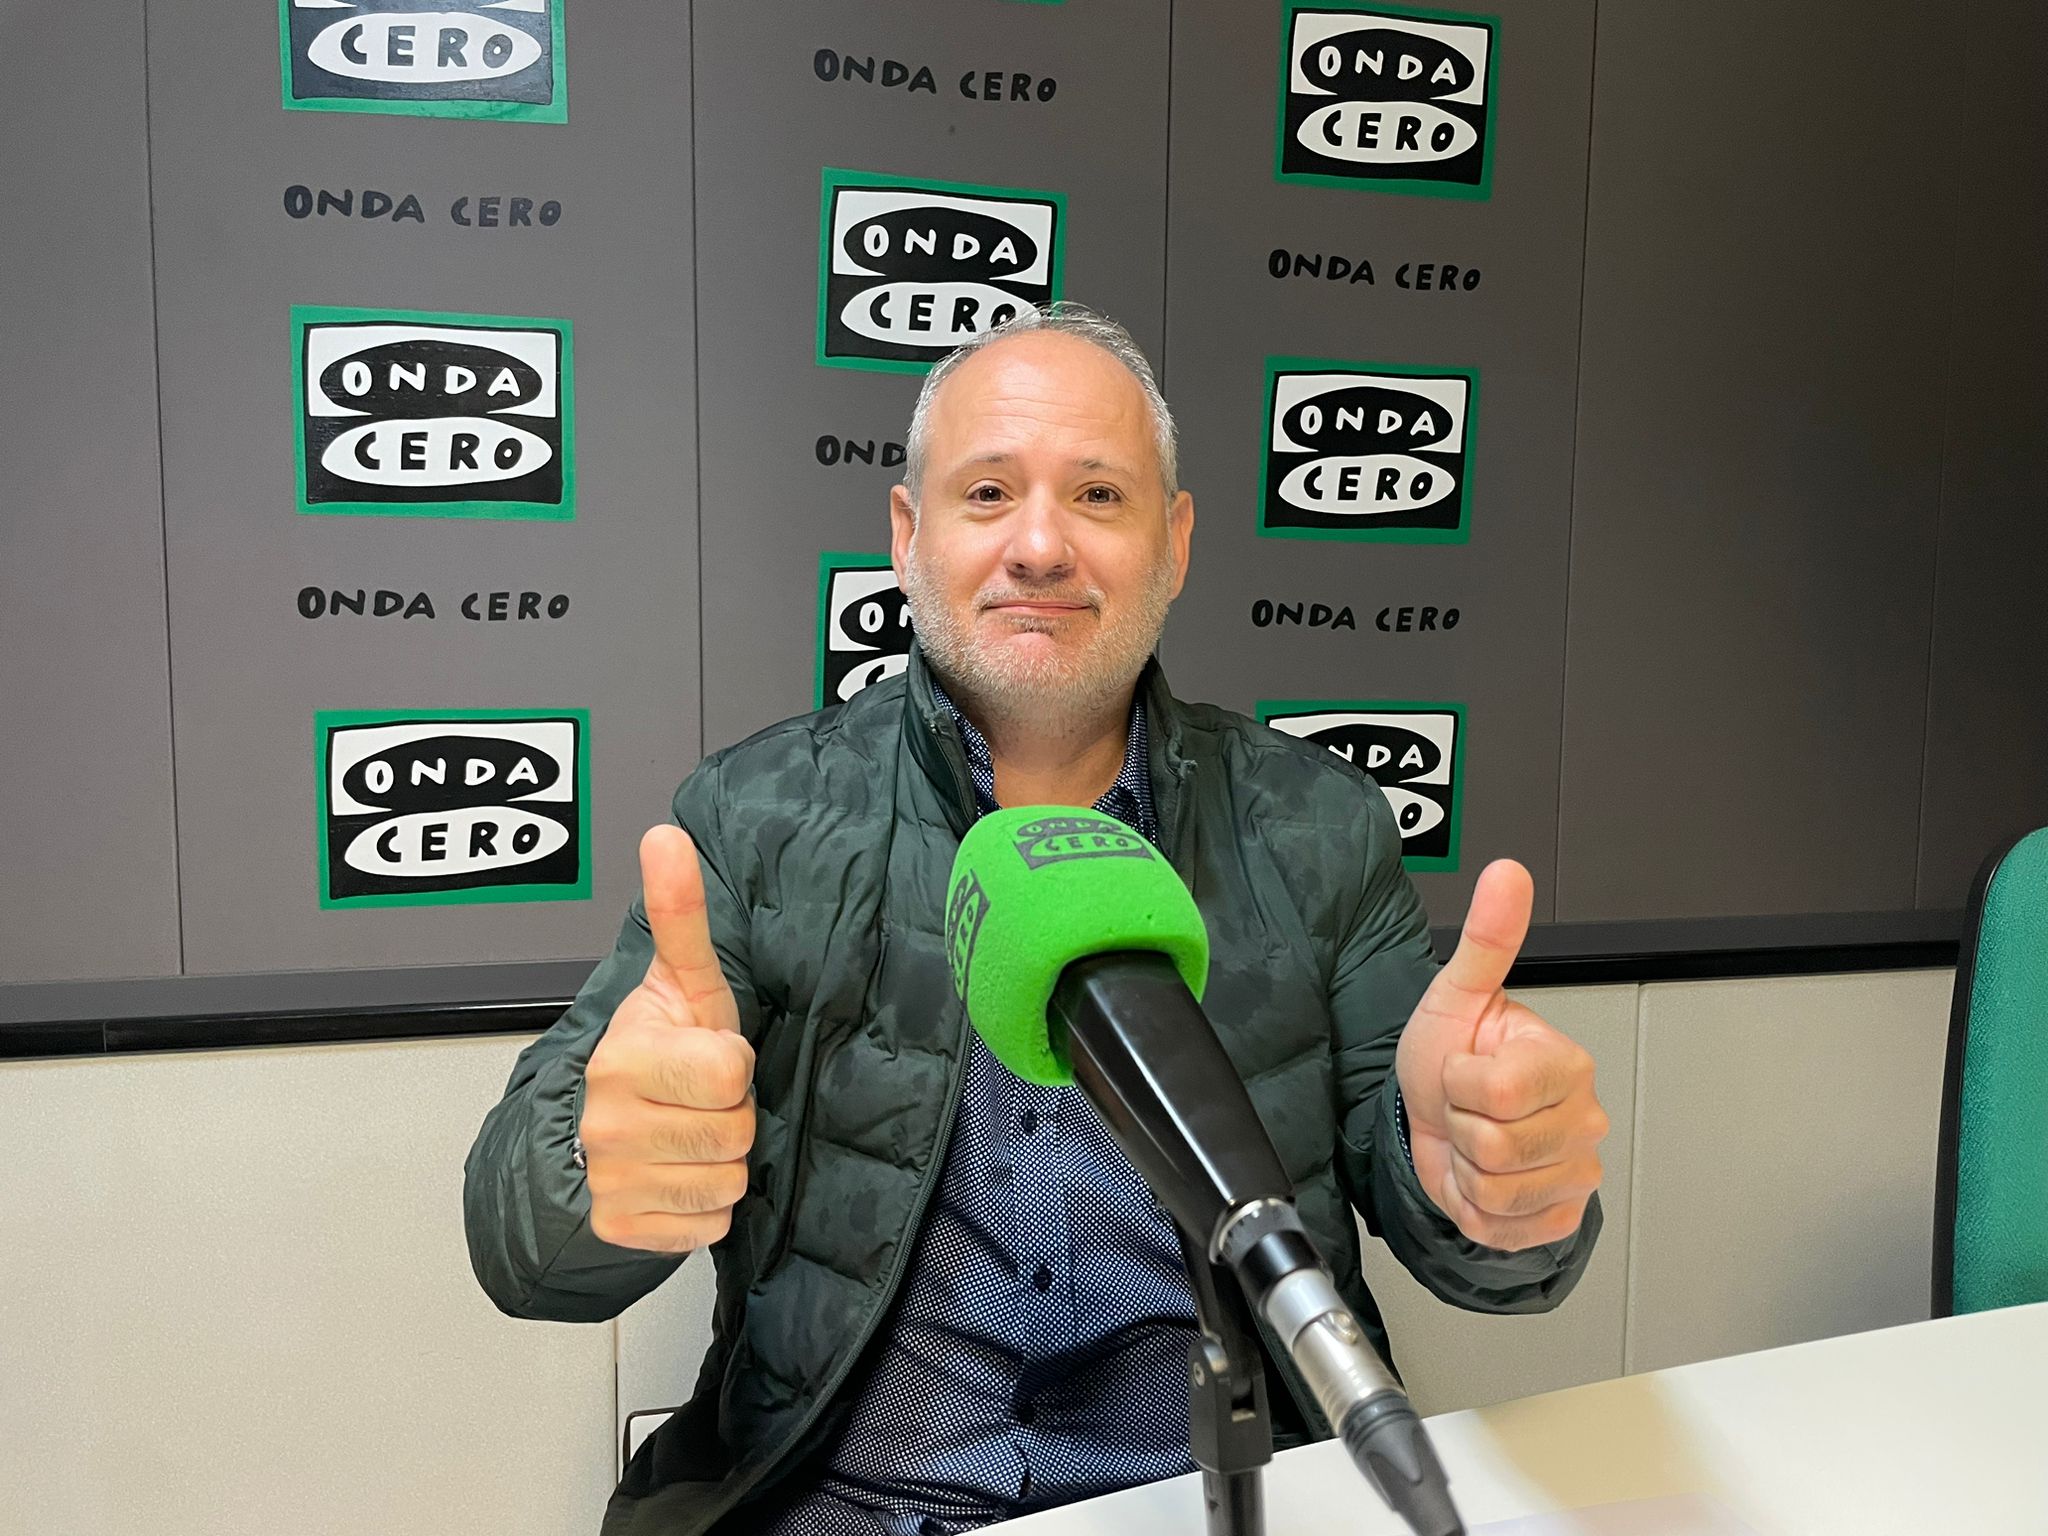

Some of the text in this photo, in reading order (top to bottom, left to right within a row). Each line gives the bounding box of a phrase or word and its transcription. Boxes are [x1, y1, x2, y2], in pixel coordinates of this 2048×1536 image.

[341, 24, 513, 69] CERO
[1319, 46, 1457, 86] ONDA
[814, 48, 1057, 102] ONDA CERO
[1323, 109, 1455, 152] CERO
[284, 184, 562, 228] ONDA CERO
[863, 224, 1018, 264] ONDA
[1268, 249, 1481, 292] ONDA CERO
[869, 291, 1017, 333] CERO
[341, 361, 521, 397] ONDA
[1300, 405, 1436, 437] ONDA
[354, 431, 523, 471] CERO
[815, 434, 908, 468] OND
[1303, 465, 1434, 502] CERO
[297, 587, 570, 622] ONDA CERO
[1252, 599, 1460, 633] ONDA CERO
[364, 757, 538, 794] ONDA
[1328, 743, 1424, 769] NDA
[377, 821, 541, 863] CERO
[1045, 836, 1129, 851] CERO
